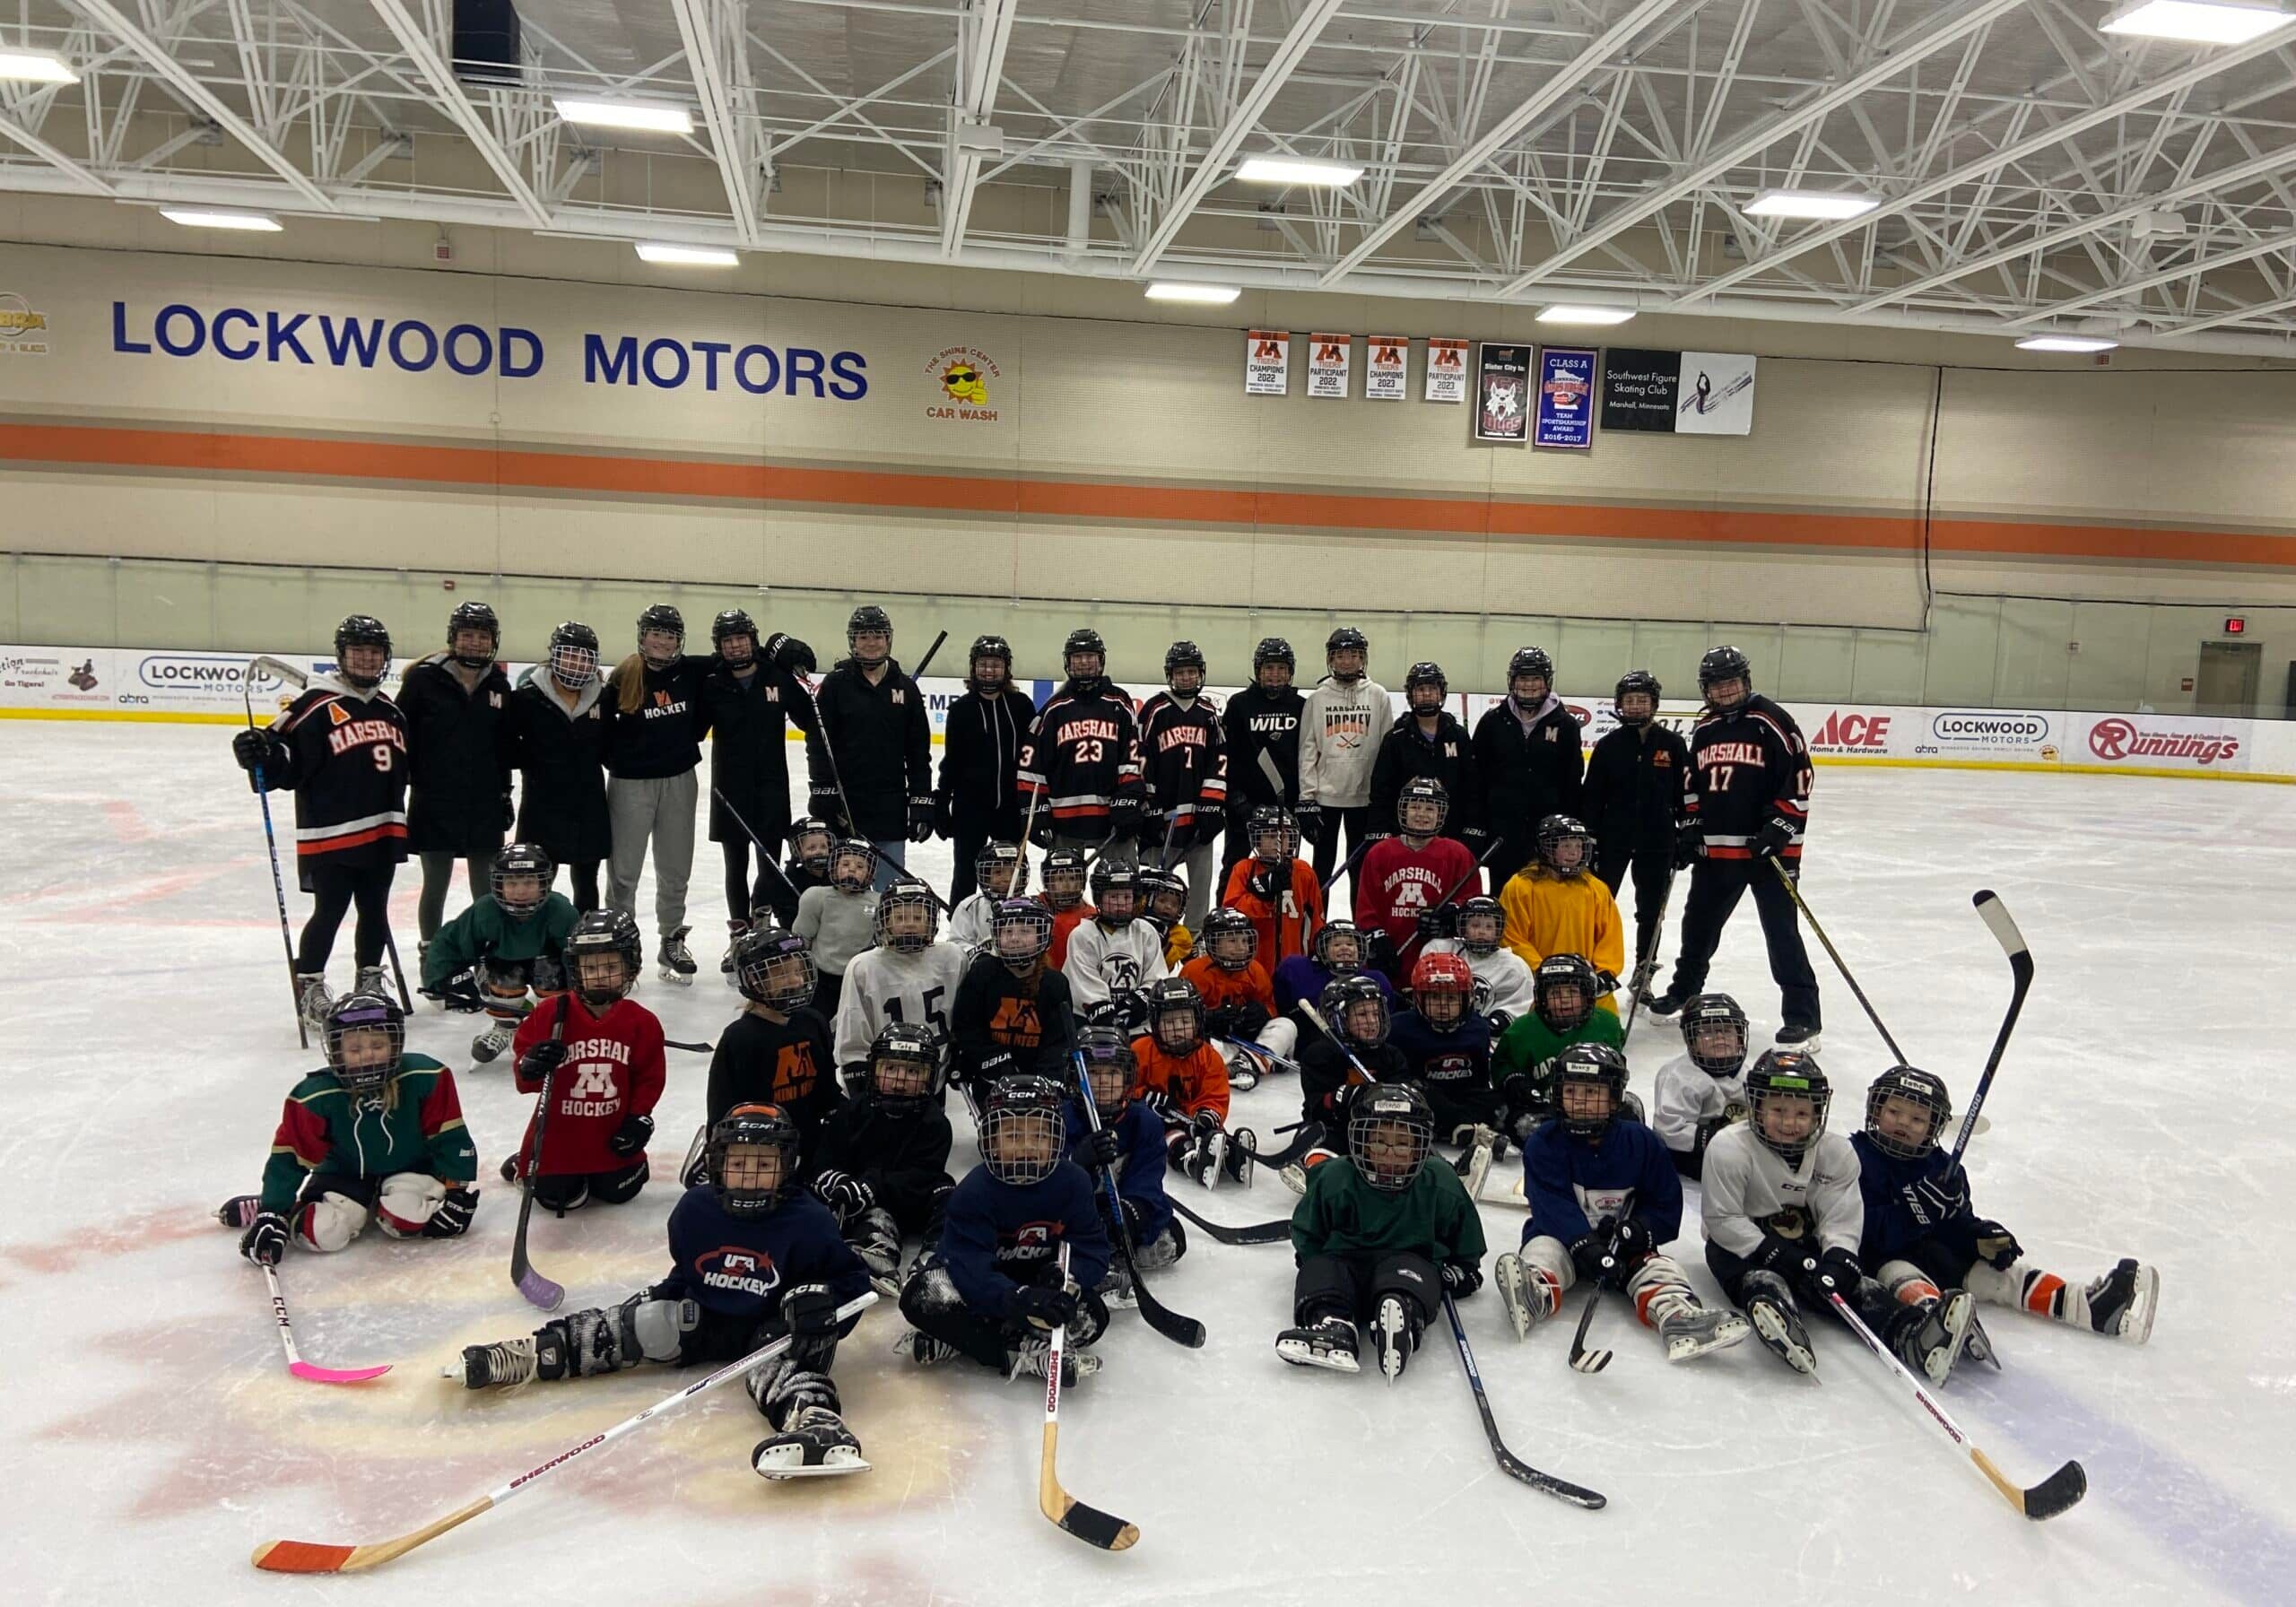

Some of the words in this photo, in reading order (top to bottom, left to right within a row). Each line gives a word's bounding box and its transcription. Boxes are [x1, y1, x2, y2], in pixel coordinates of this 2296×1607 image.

[113, 300, 544, 379] LOCKWOOD
[584, 333, 868, 401] MOTORS
[925, 357, 940, 373] THE
[939, 346, 967, 359] SHINE
[970, 347, 1000, 378] CENTER
[1249, 364, 1284, 374] CHAMPIONS
[1504, 364, 1517, 373] City
[1549, 359, 1578, 368] CLASS
[1580, 360, 1587, 369] A
[1257, 373, 1275, 383] 2022
[1309, 368, 1347, 378] PARTICIPANT
[1370, 370, 1404, 379] CHAMPIONS
[1428, 372, 1465, 381] PARTICIPANT
[1606, 369, 1650, 381] Southwest
[1651, 372, 1677, 385] Figure
[1319, 377, 1337, 387] 2022
[1378, 378, 1396, 388] 2023
[1437, 380, 1455, 390] 2023
[1614, 382, 1646, 395] Skating
[1648, 384, 1668, 395] Club
[926, 406, 955, 419] CAR
[959, 408, 997, 421] WASH
[1544, 433, 1582, 442] 2016-2017
[118, 692, 149, 704] abra
[489, 690, 502, 708] M
[765, 686, 779, 703] M
[891, 689, 905, 705] M
[644, 700, 687, 719] HOCKEY
[1249, 717, 1298, 732] WILD
[1326, 713, 1371, 738] HOCKEY
[1811, 709, 1892, 746] ACE
[1943, 720, 2039, 734] LOCKWOOD
[1545, 726, 1559, 743] M
[1981, 735, 2030, 744] MOTORS
[2088, 717, 2239, 765] Runnings
[1074, 739, 1104, 763] 23
[1444, 742, 1458, 758] M
[1810, 745, 1834, 754] Home
[1846, 746, 1888, 755] Hardware
[1915, 744, 1938, 754] abra
[372, 744, 392, 772] 9
[1184, 746, 1193, 769] 7
[1709, 766, 1735, 791] 17
[1384, 866, 1443, 895] MARSHALL
[883, 985, 949, 1047] 15
[561, 1098, 622, 1117] HOCKEY
[1955, 1093, 1982, 1152] SHERWOOD
[703, 1271, 769, 1298] HOCKEY
[273, 1297, 291, 1327] CCM
[1048, 1350, 1059, 1413] SHERWOOD
[1916, 1390, 1962, 1446] SHERWOOD
[509, 1434, 606, 1490] SHERWOOD
